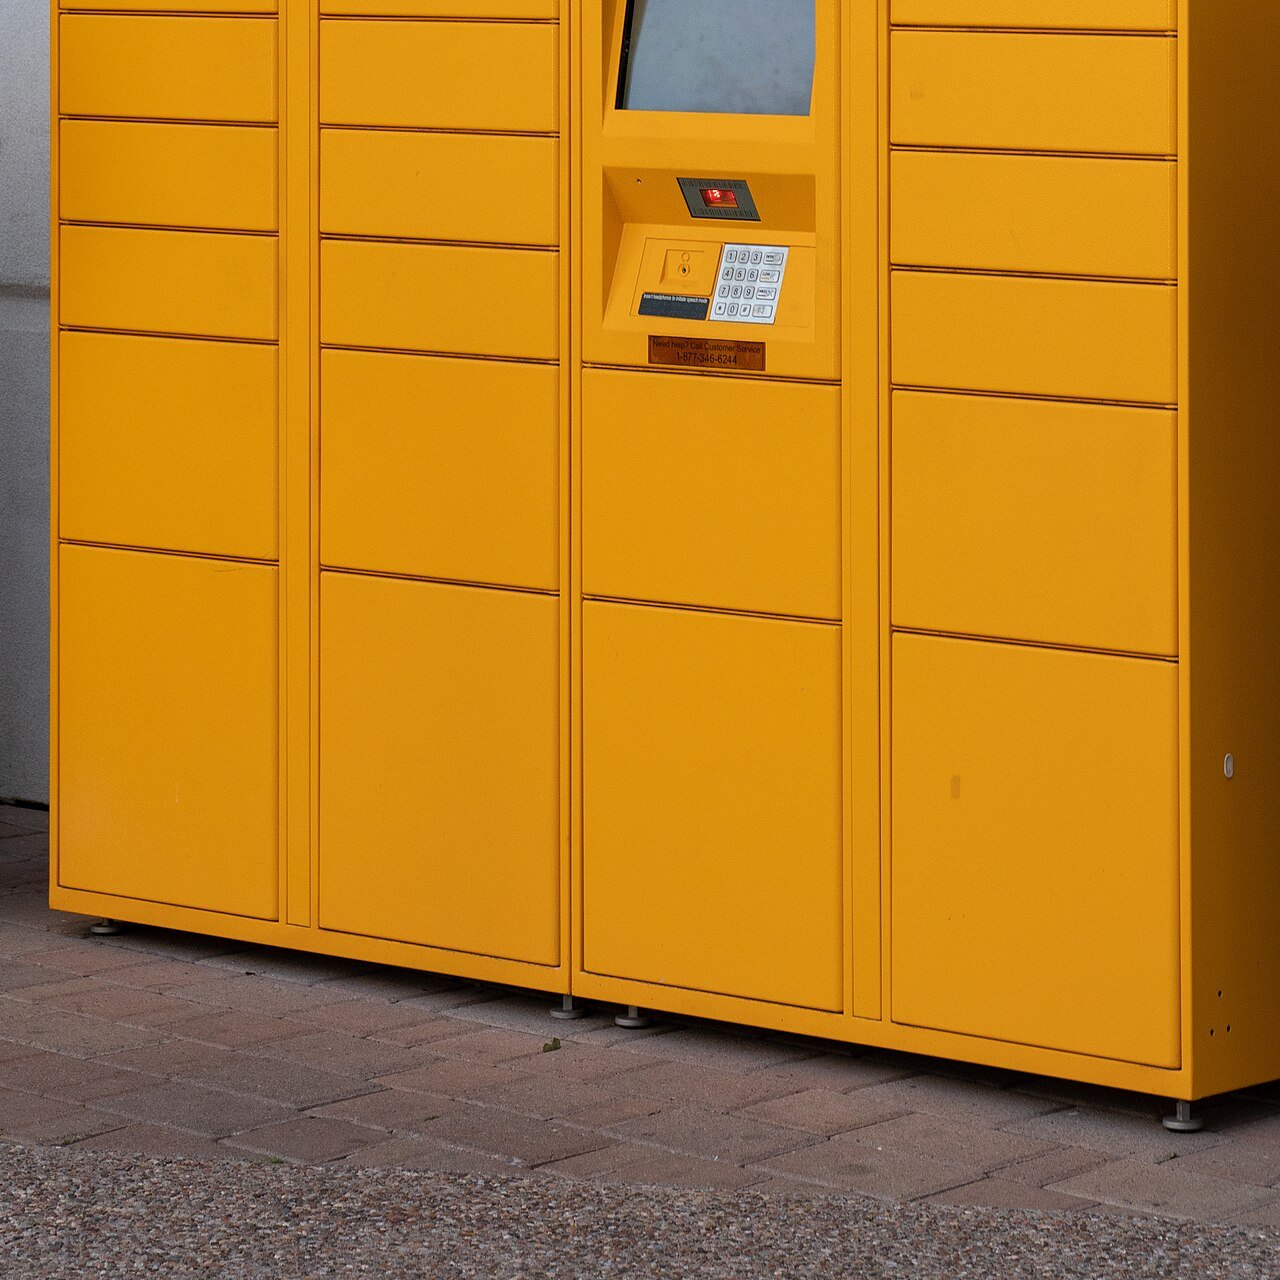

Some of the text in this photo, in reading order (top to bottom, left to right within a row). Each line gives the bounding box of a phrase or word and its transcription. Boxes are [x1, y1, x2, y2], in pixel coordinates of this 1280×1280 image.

[652, 339, 670, 348] Need
[690, 342, 703, 350] Call
[704, 343, 735, 353] Customer
[736, 345, 761, 354] Service
[677, 352, 737, 365] 1-877-346-6244
